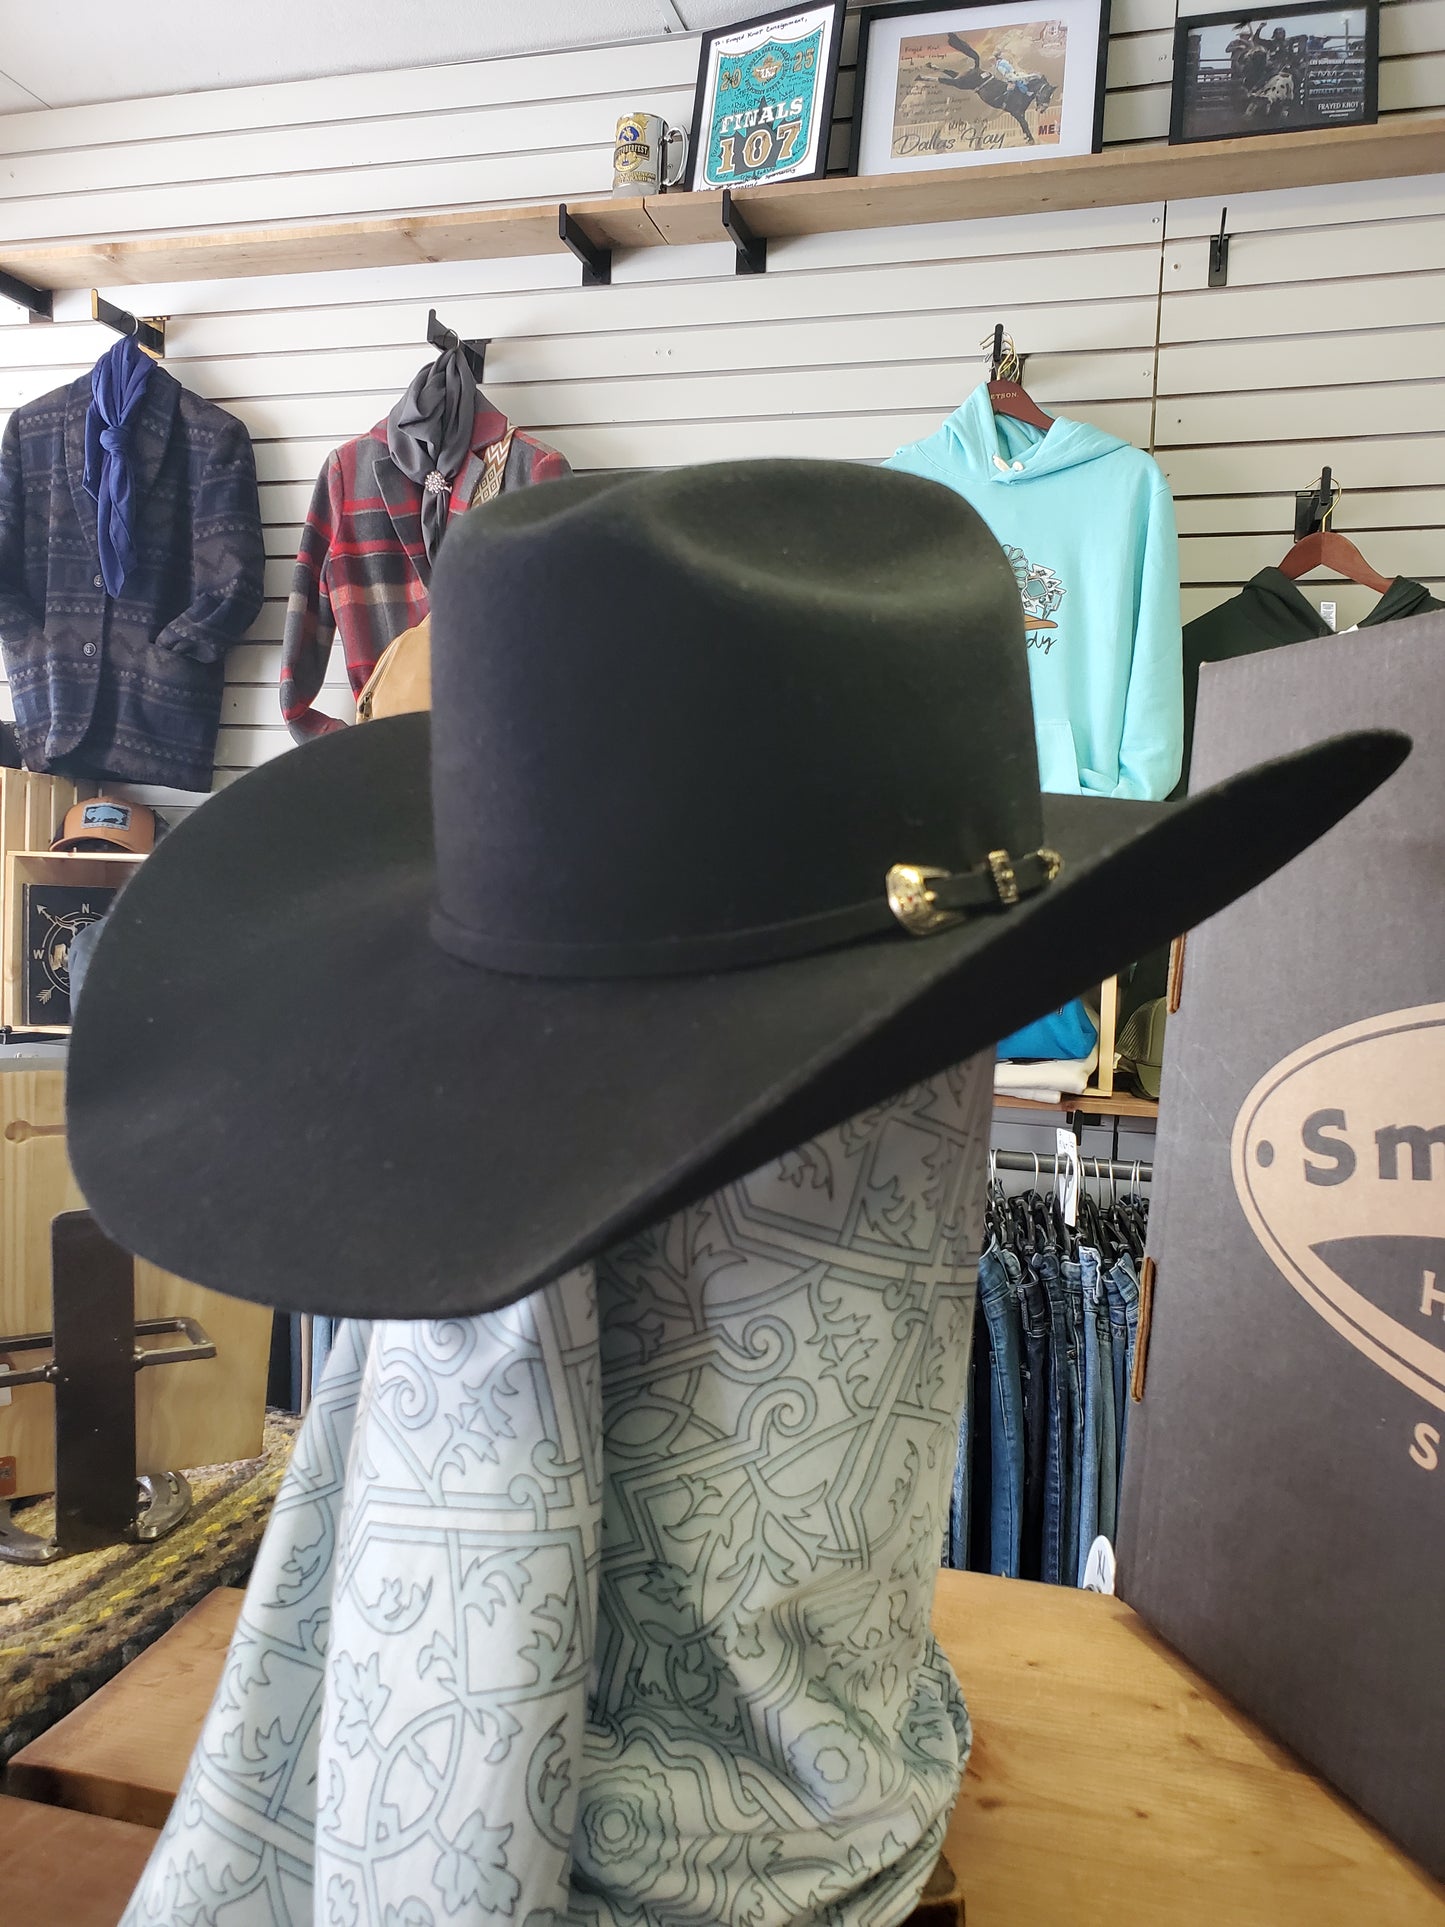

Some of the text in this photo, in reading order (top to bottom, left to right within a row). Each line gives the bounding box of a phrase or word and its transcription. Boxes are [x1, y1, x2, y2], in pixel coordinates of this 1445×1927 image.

[793, 46, 816, 74] 25
[719, 96, 803, 134] FINALS
[716, 120, 802, 175] 107
[894, 126, 1006, 155] Dallas Hay
[82, 903, 90, 913] N
[33, 949, 44, 959] W
[1302, 1108, 1445, 1187] Sm
